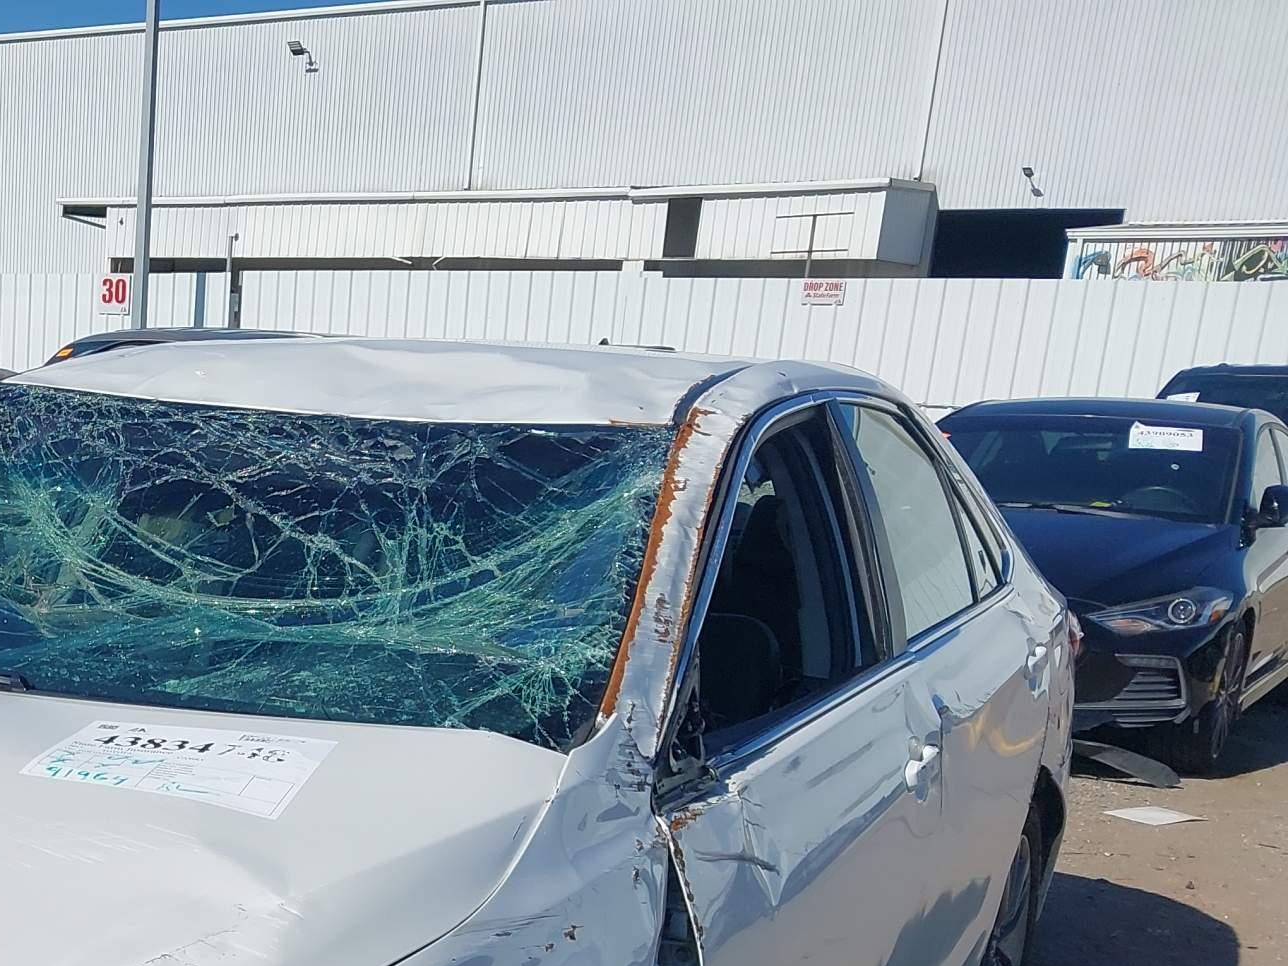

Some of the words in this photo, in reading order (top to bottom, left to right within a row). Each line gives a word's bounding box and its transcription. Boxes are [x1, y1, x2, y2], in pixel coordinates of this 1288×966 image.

[102, 278, 127, 304] 30
[803, 282, 823, 291] DROP
[824, 282, 844, 291] ZONE
